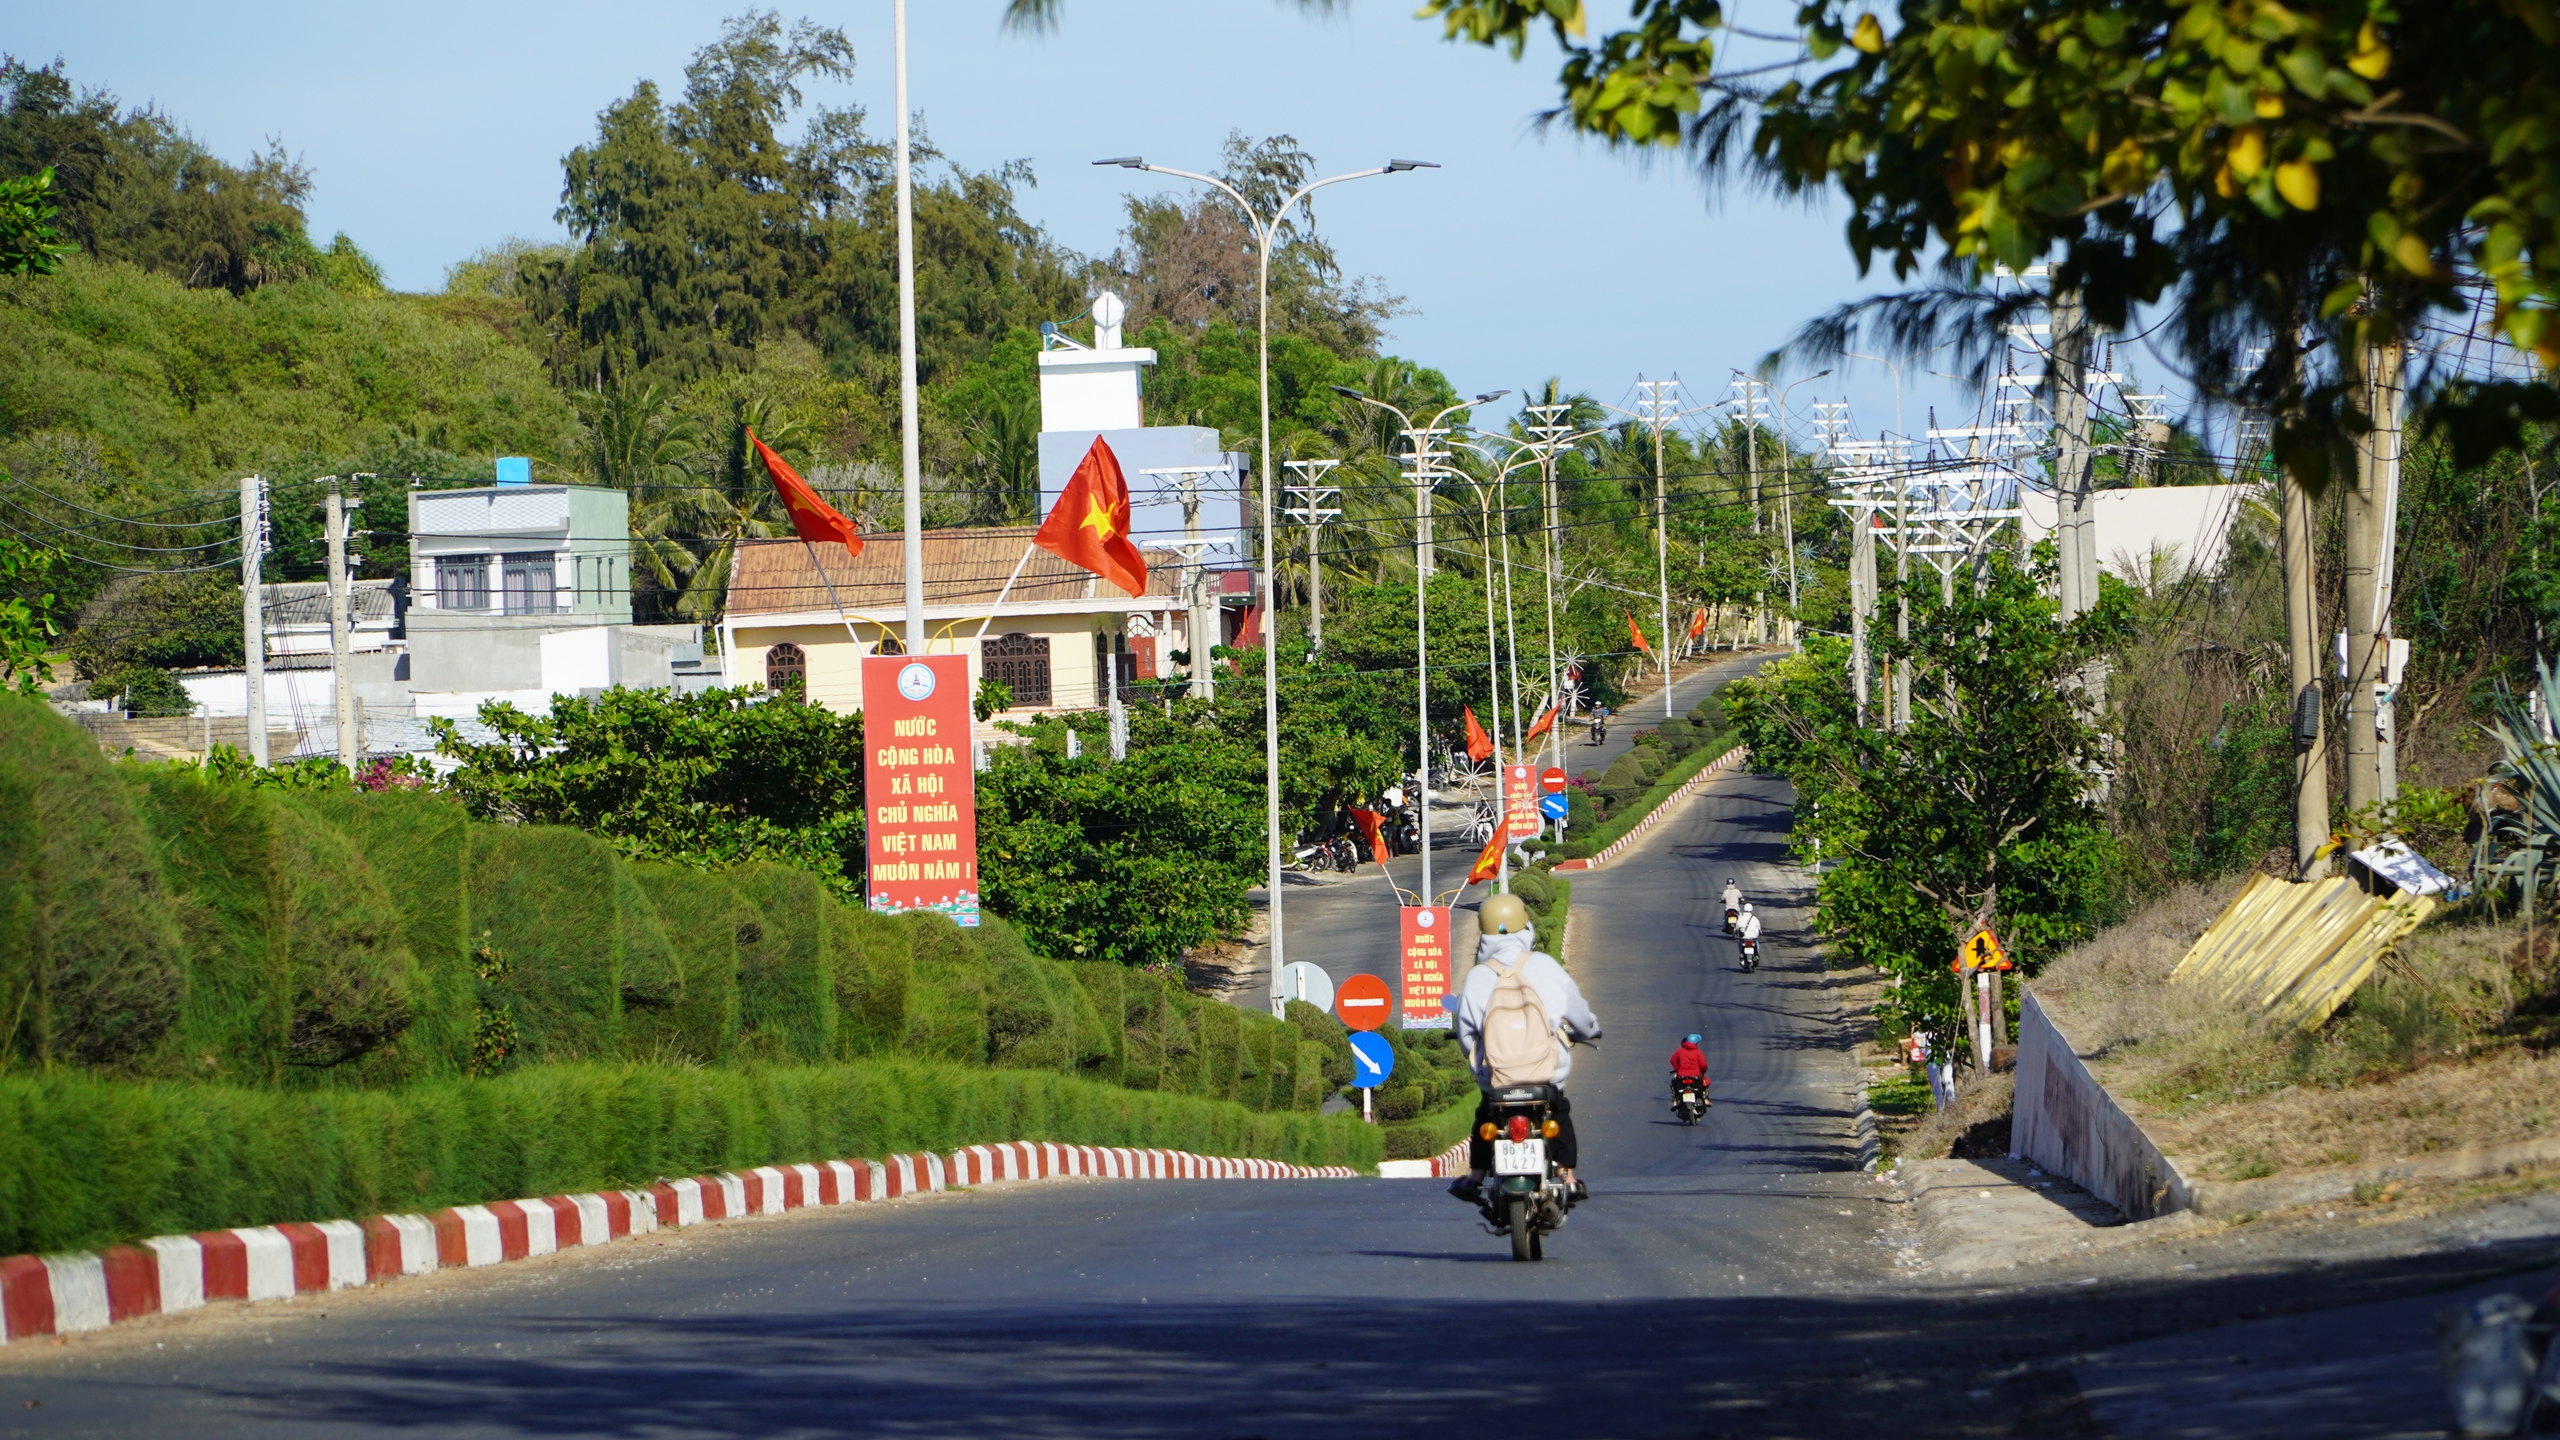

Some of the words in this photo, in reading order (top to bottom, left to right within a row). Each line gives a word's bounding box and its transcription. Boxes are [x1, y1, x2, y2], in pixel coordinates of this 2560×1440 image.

[894, 715, 937, 737] NƯỚC
[877, 745, 919, 770] CỘNG
[923, 743, 955, 765] HÒA
[891, 773, 912, 795] XÃ
[917, 772, 944, 798] HỘI
[877, 800, 908, 824] CHỦ
[913, 801, 958, 823] NGHĨA
[881, 831, 917, 856] VIỆT
[921, 833, 957, 852] NAM
[873, 860, 920, 882] MUÔN
[924, 859, 960, 880] NĂM
[1415, 934, 1434, 943] NƯỚC
[1407, 947, 1426, 958] CỘNG
[1428, 947, 1442, 957] HÒA
[1413, 959, 1423, 969] XÃ
[1425, 959, 1437, 970] HỘI
[1407, 971, 1421, 982] CHỦ
[1423, 971, 1444, 982] NGHĨA
[1409, 985, 1425, 996] VIỆT
[1426, 986, 1443, 995] NAM
[1404, 997, 1426, 1008] MUÔN
[1503, 1157, 1536, 1170] 1427
